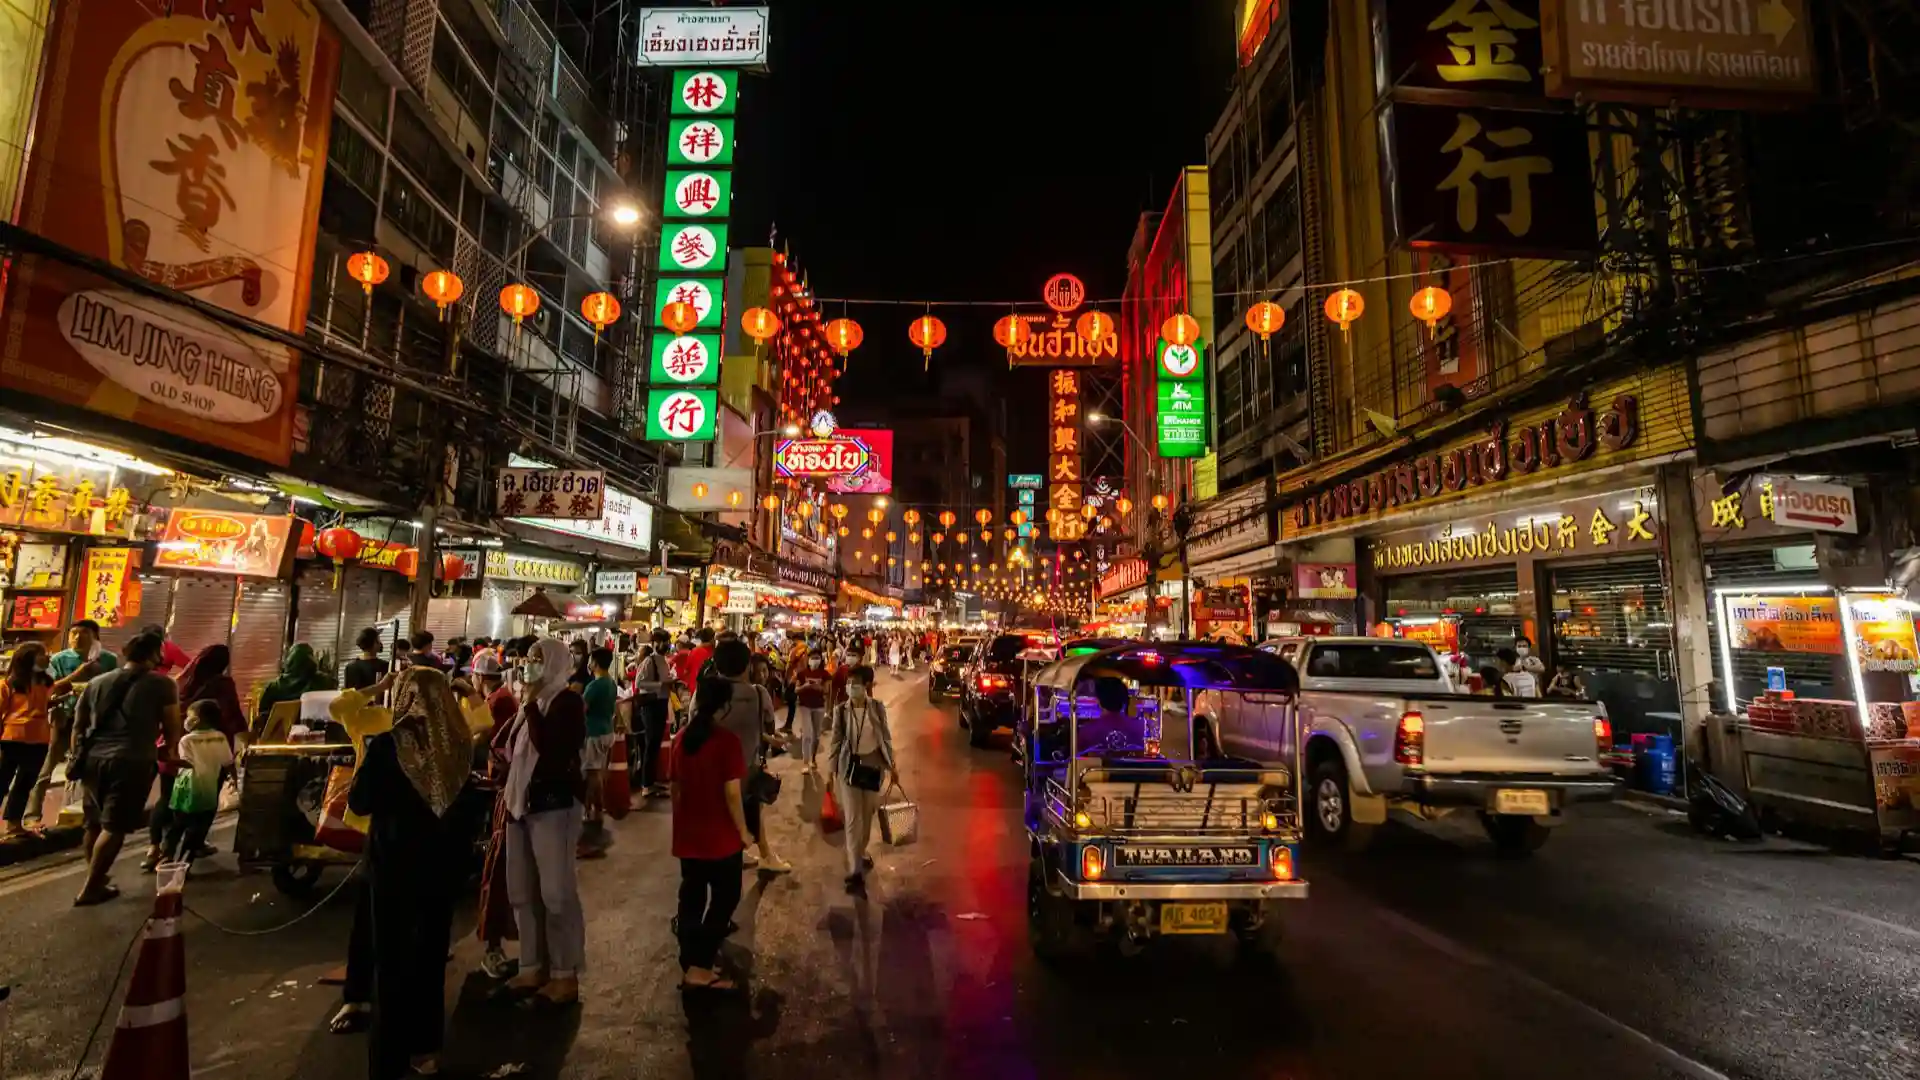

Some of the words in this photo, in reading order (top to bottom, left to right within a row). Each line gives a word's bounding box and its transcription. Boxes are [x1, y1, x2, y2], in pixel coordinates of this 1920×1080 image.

[71, 294, 133, 356] LIM
[134, 322, 201, 385] JING
[205, 349, 277, 413] HIENG
[151, 381, 178, 400] OLD
[182, 390, 216, 412] SHOP
[1171, 400, 1192, 411] ATM
[1123, 846, 1253, 864] THAILAND
